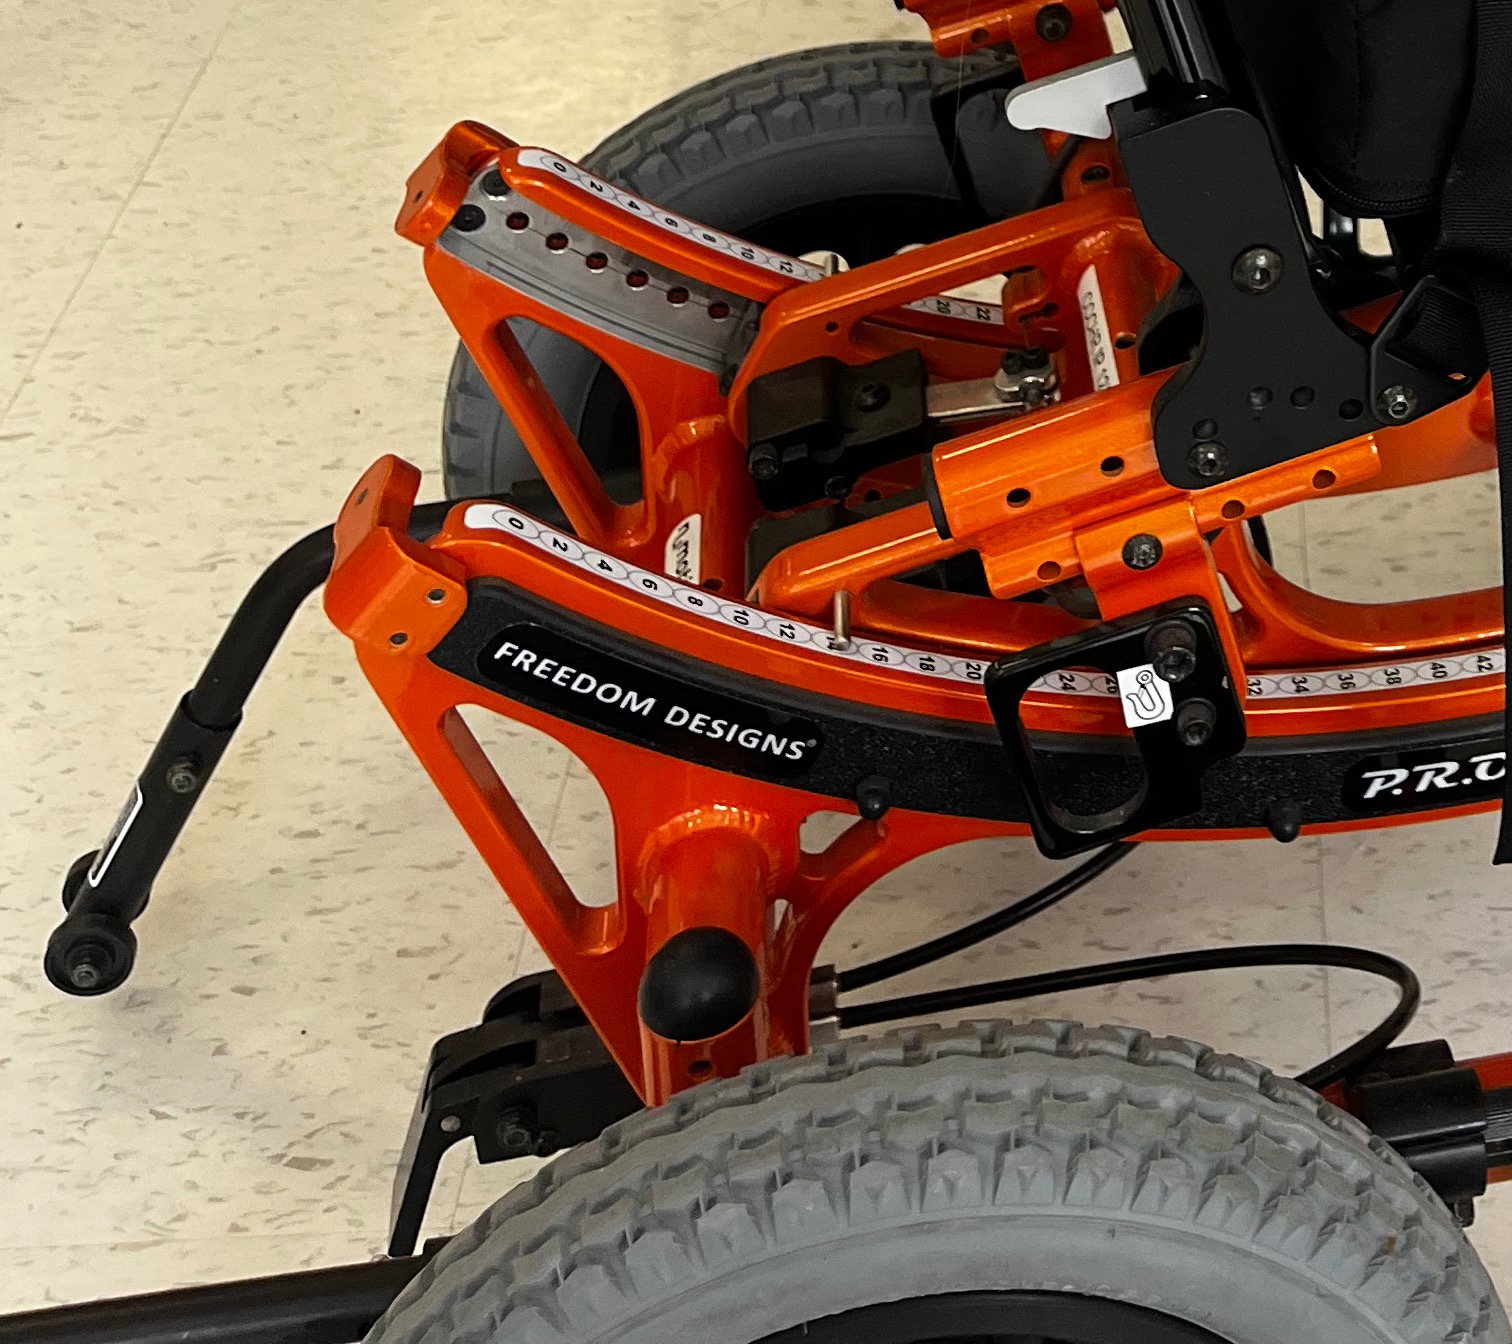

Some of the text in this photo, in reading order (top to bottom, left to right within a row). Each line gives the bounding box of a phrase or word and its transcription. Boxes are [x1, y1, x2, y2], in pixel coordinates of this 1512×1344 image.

[553, 162, 991, 322] 0 2 4 6 8 10 12 20 22
[508, 516, 524, 531] 0
[552, 537, 569, 553] 2
[597, 558, 613, 572] 4
[642, 578, 658, 591] 6
[687, 594, 704, 608] 8
[733, 608, 750, 626] 10
[779, 623, 796, 641] 12
[871, 645, 889, 663] 16
[919, 655, 936, 673] 18
[965, 662, 983, 681] 20
[1059, 673, 1077, 691] 24
[1247, 679, 1263, 697] 32
[1291, 676, 1310, 695] 34
[1338, 673, 1356, 690] 36
[1384, 667, 1403, 686] 38
[1430, 661, 1449, 680] 40
[1477, 654, 1495, 673] 42
[493, 641, 806, 761] FREEDOM DESIGNS
